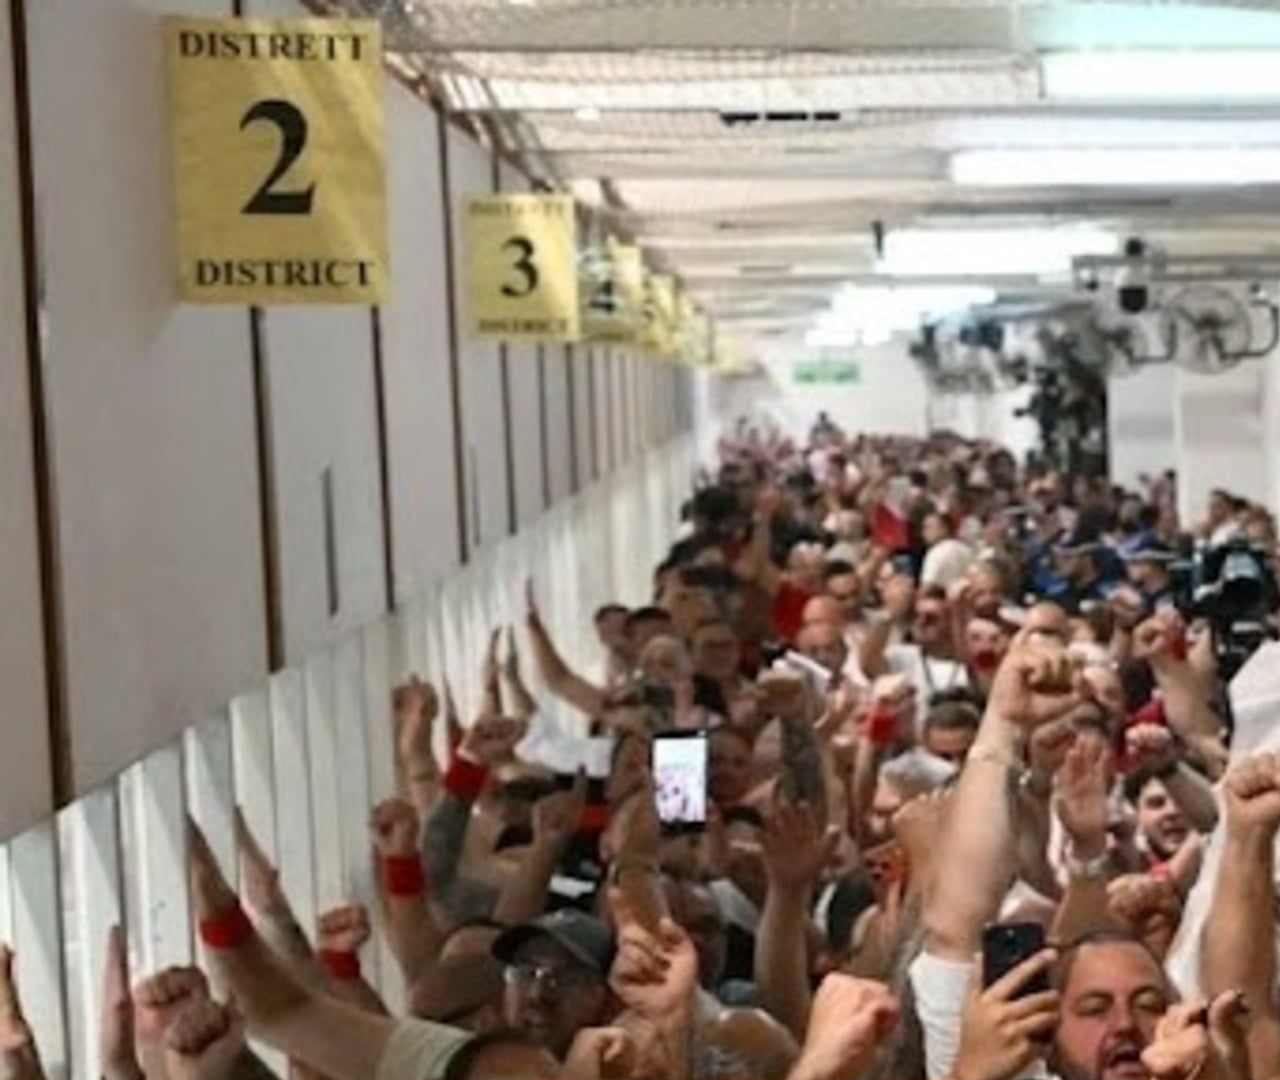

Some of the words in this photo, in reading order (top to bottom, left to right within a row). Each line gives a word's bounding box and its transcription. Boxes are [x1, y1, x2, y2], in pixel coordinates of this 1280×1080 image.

[179, 32, 366, 61] DISTRETT
[239, 98, 316, 215] 2
[195, 260, 375, 287] DISTRICT
[500, 235, 539, 298] 3
